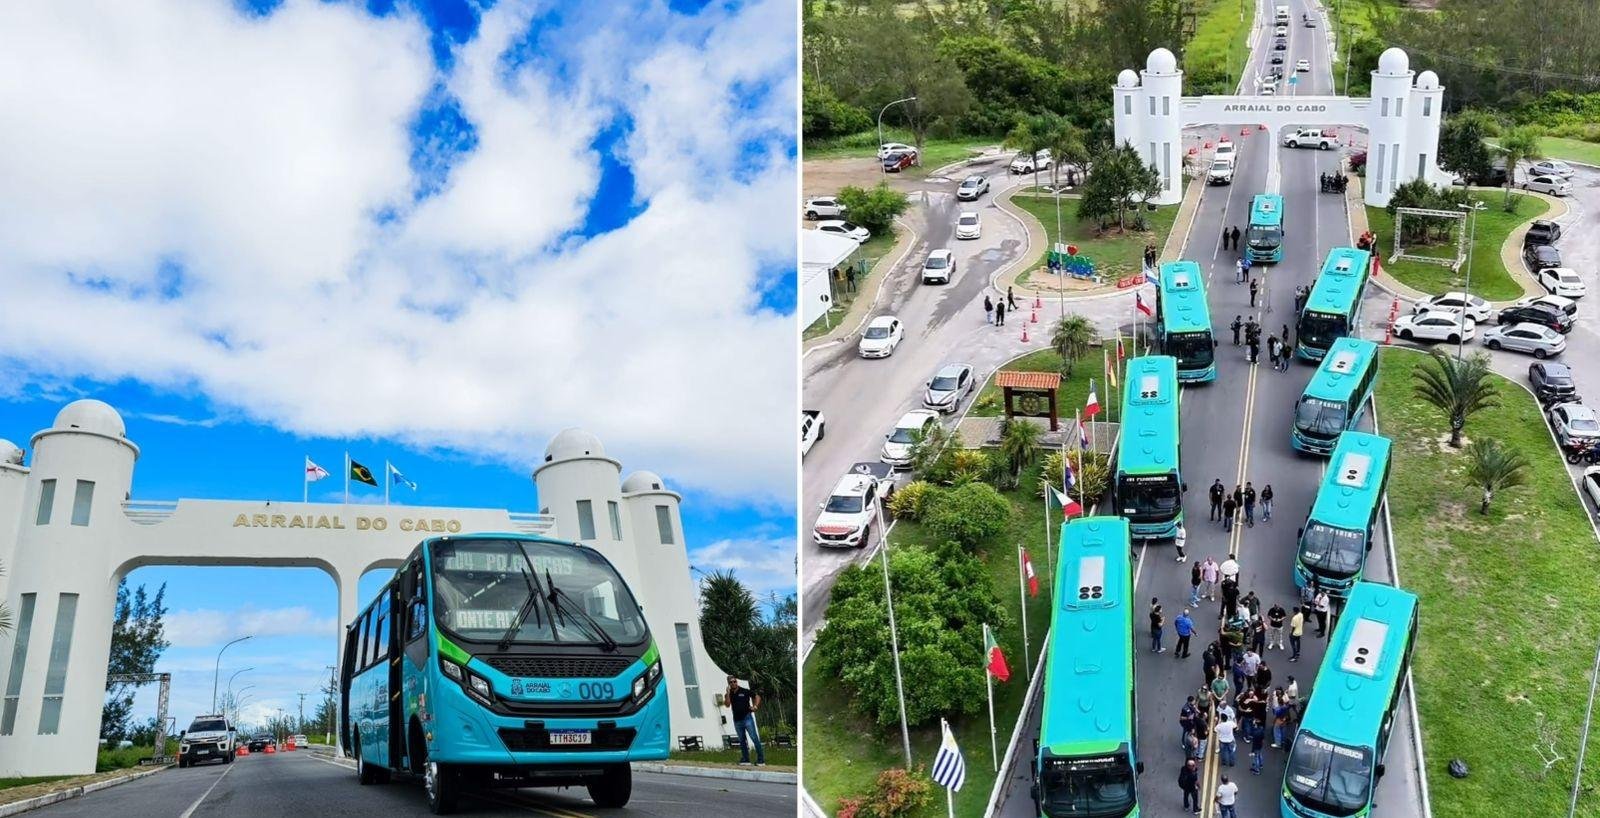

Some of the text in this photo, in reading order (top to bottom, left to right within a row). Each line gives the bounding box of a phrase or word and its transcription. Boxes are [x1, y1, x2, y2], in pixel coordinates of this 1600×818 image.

[1224, 104, 1272, 112] ARRAIAL
[232, 513, 462, 533] ARRAIAL DO CABO
[456, 611, 494, 629] ONTE
[578, 681, 614, 700] 009
